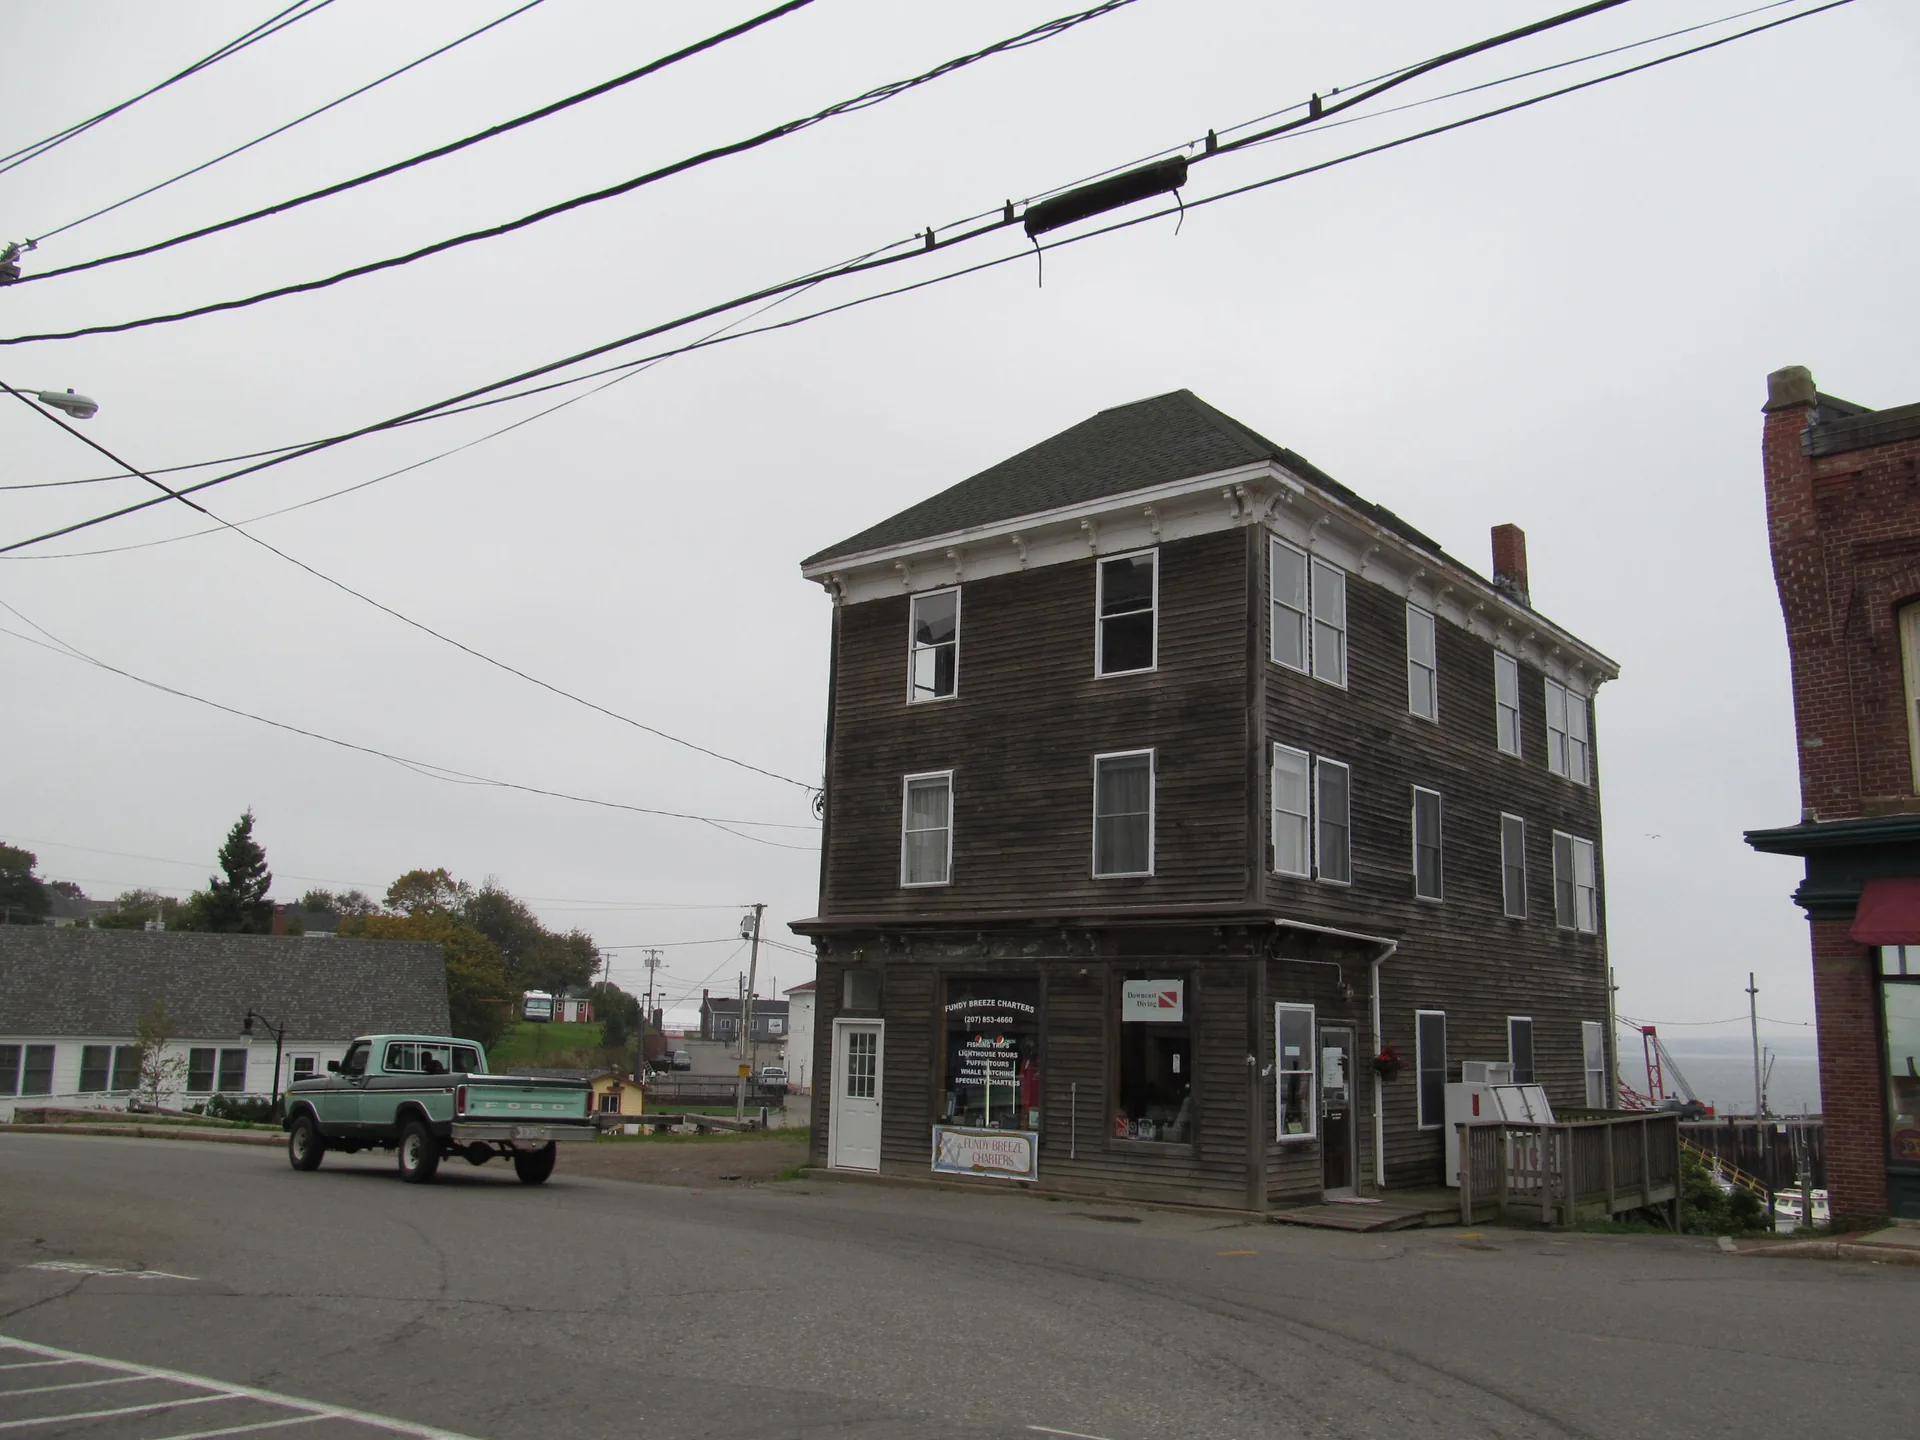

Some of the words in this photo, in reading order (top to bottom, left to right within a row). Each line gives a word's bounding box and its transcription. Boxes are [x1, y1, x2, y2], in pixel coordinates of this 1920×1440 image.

[1127, 991, 1157, 999] Downeast
[945, 1001, 967, 1012] FUNDY
[969, 999, 995, 1007] BREEZE
[997, 1000, 1035, 1013] CHARTERS
[1136, 1000, 1157, 1008] Diving
[964, 1016, 981, 1024] (207)
[982, 1069, 1015, 1077] WATCHING
[955, 1077, 987, 1085] SPECIALTY
[988, 1079, 1021, 1087] CHARTERS
[485, 1102, 564, 1110] FORD
[963, 1138, 989, 1150] FUNDY
[992, 1139, 1024, 1153] BREEZE
[972, 1151, 1014, 1166] CHARTERS
